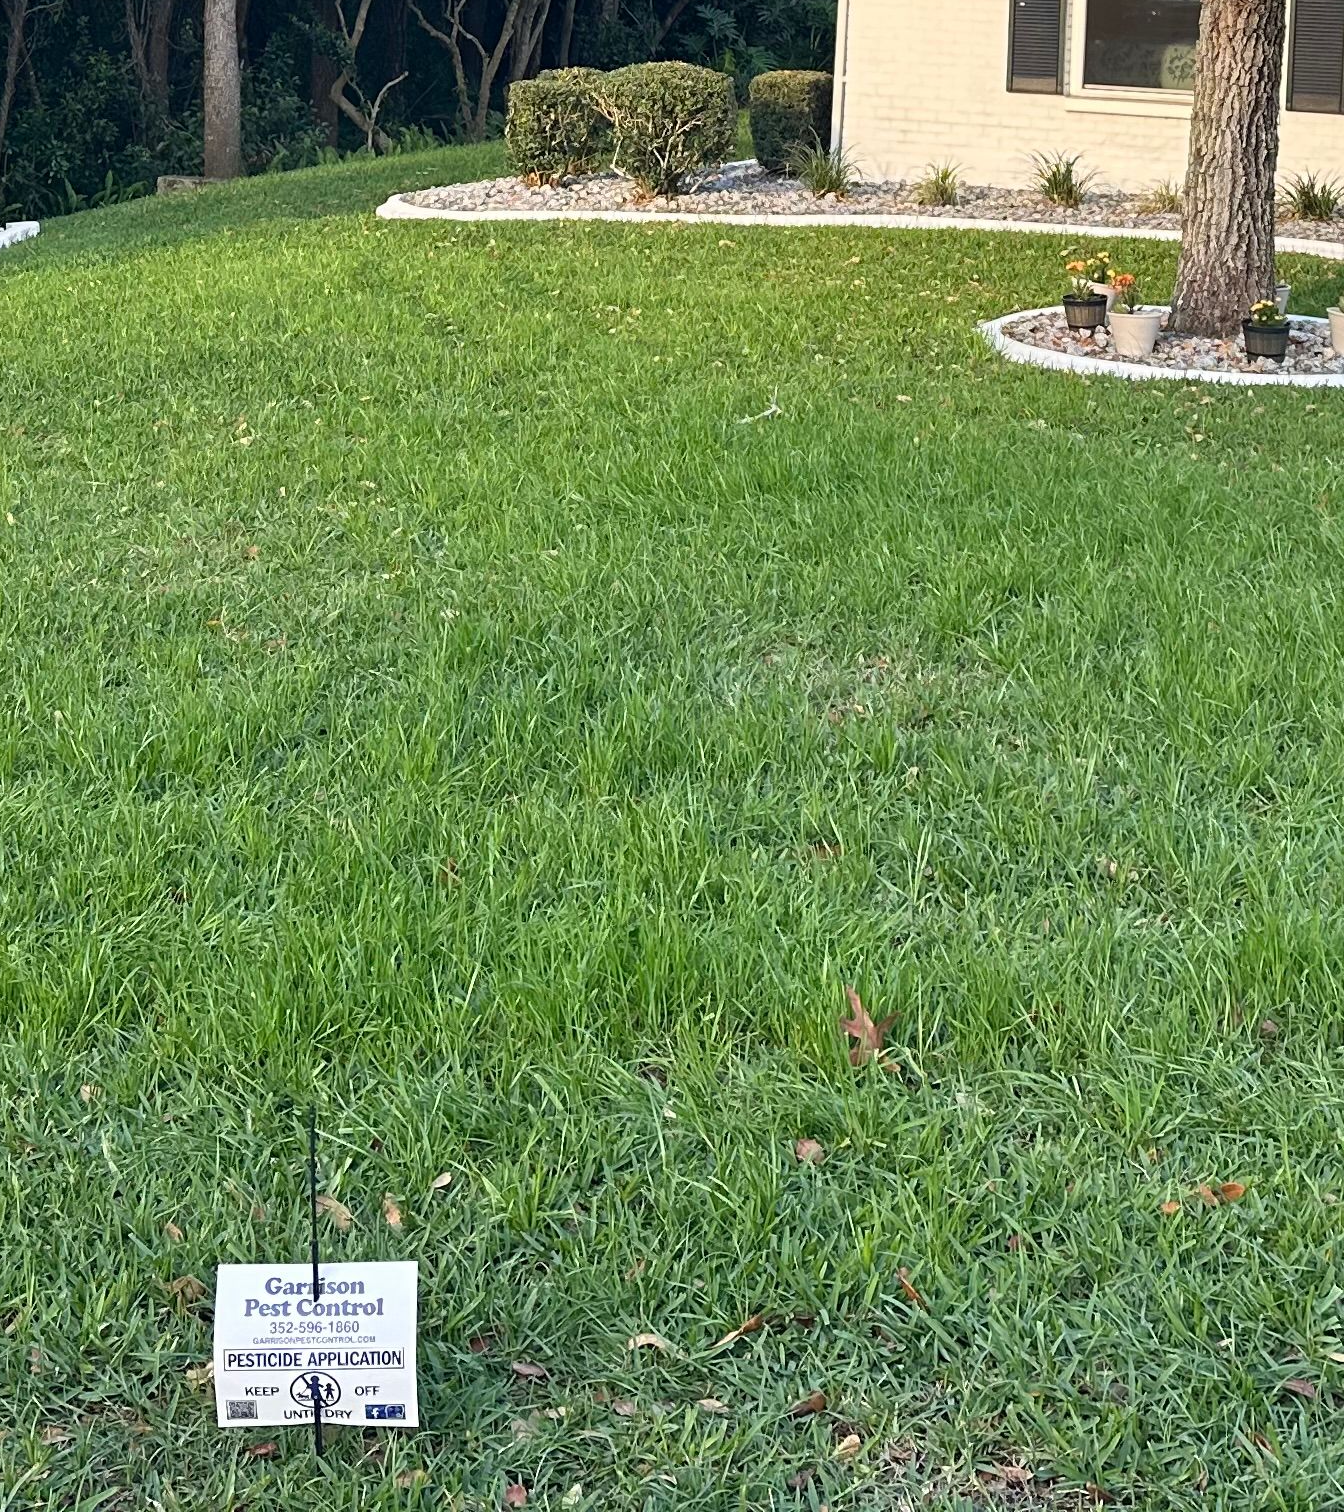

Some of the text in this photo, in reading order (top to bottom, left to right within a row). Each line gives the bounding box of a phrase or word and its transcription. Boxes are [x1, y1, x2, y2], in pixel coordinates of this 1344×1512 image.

[244, 1298, 384, 1317] Pest Control
[269, 1321, 360, 1334] 352-596-1860
[228, 1351, 402, 1368] PESTICIDE APPLICATION
[245, 1386, 380, 1397] KEEP OFF
[283, 1409, 353, 1420] UNTI DRY
